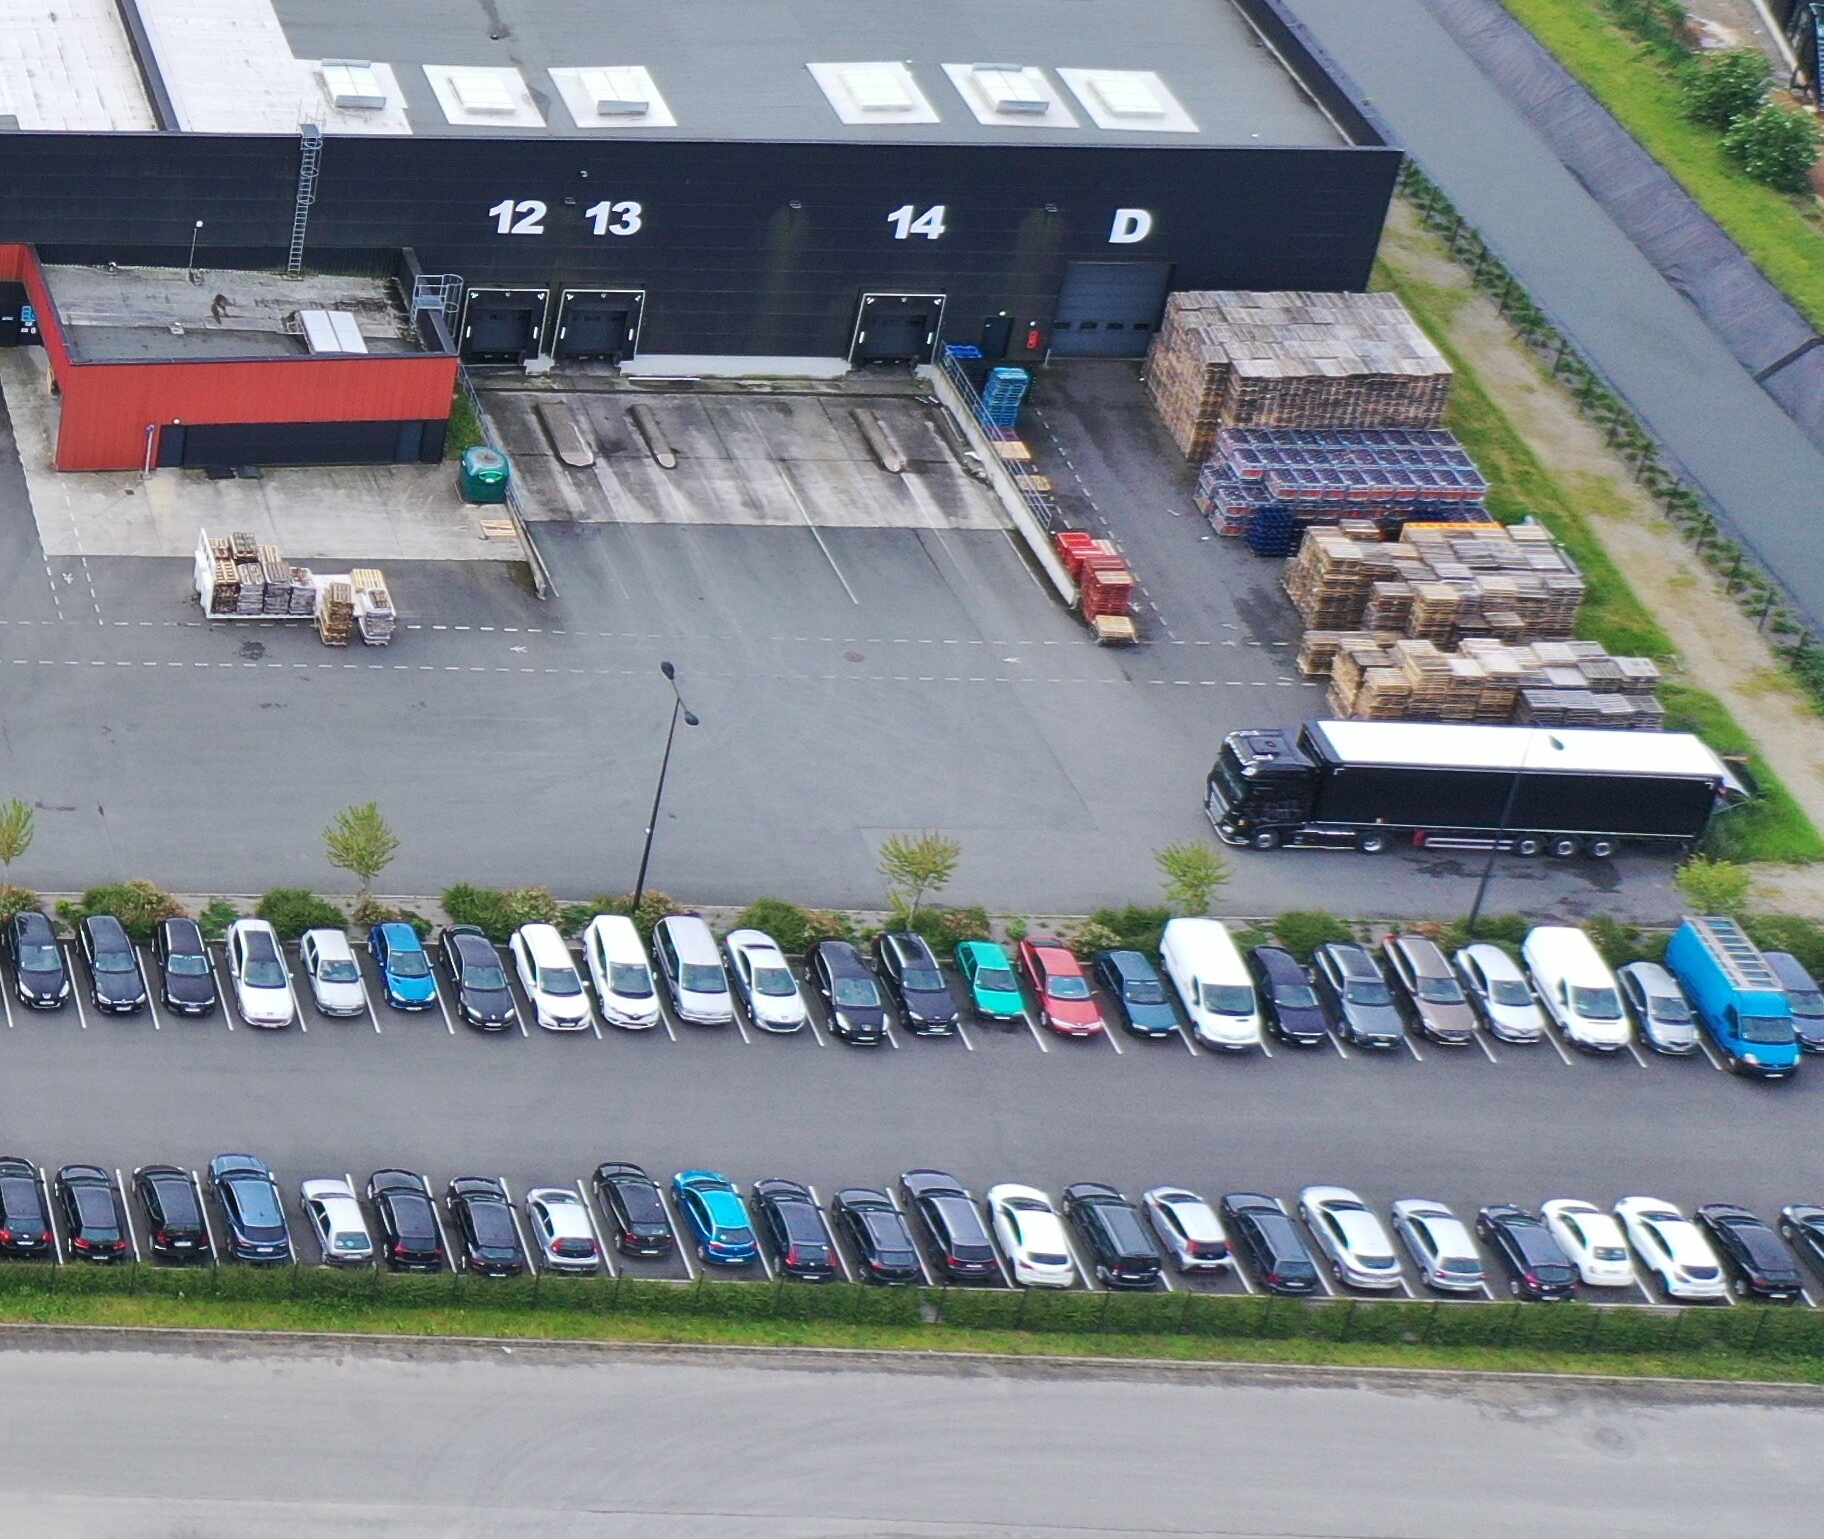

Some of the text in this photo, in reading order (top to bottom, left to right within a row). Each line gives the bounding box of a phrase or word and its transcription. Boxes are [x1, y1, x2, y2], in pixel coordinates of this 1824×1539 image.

[488, 199, 547, 235] 12
[585, 200, 642, 236] 13
[887, 205, 946, 240] 14
[1108, 208, 1153, 244] D
